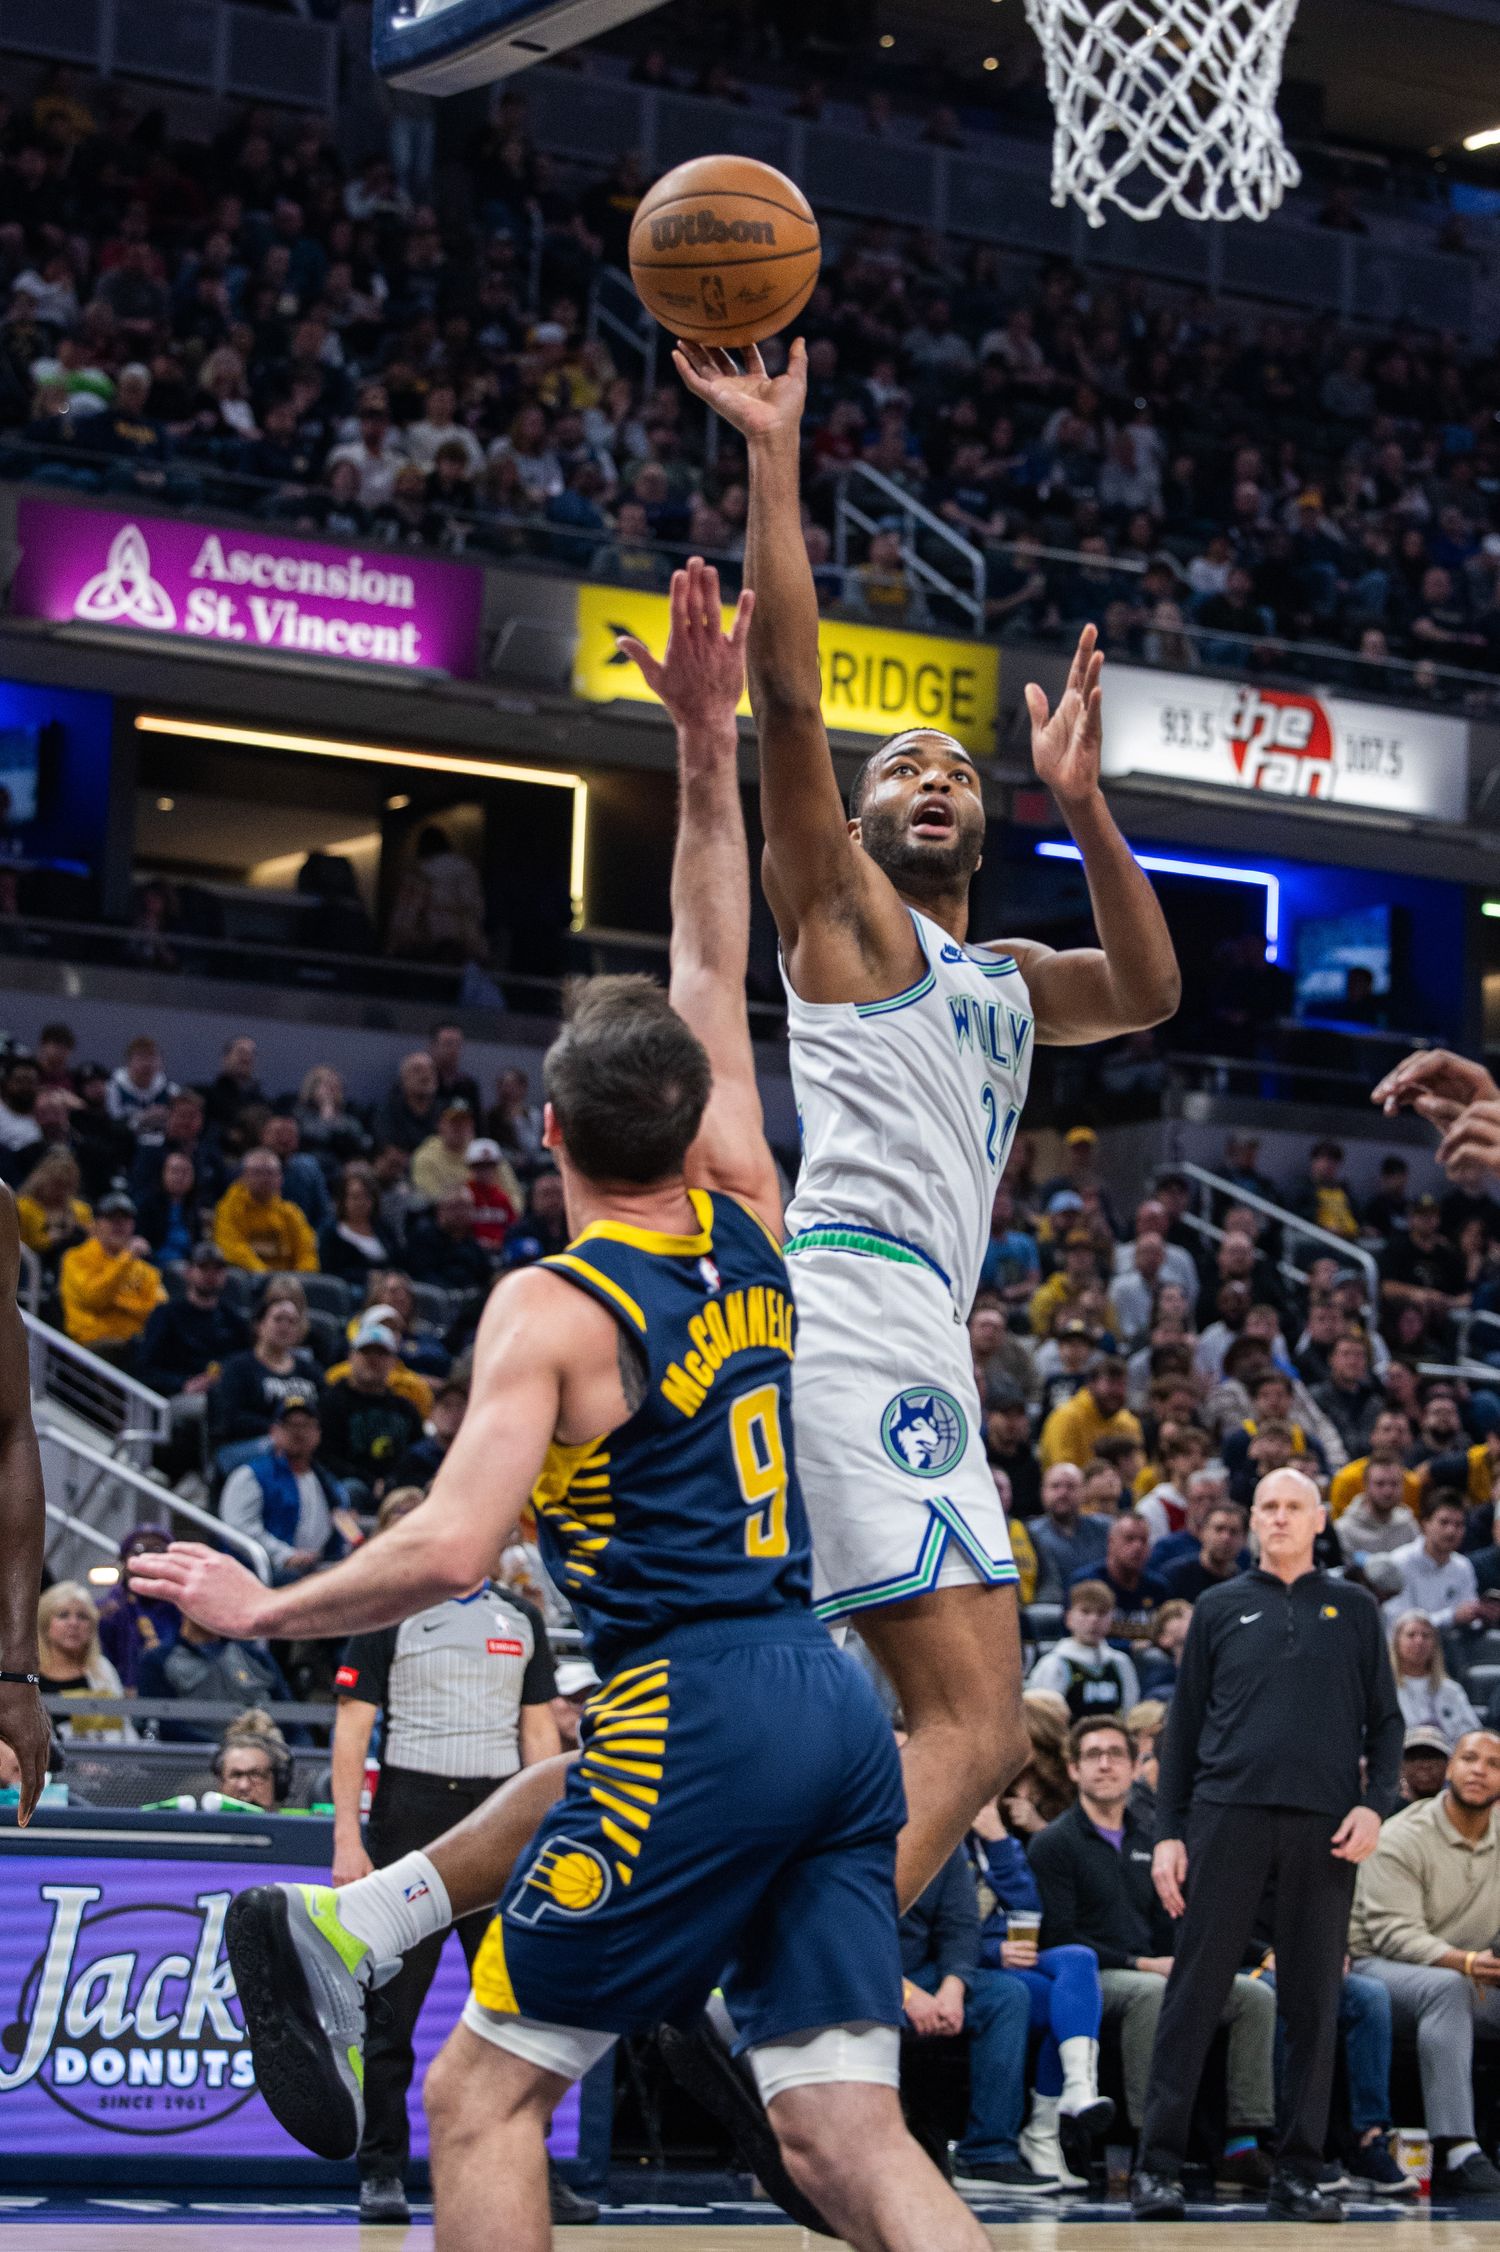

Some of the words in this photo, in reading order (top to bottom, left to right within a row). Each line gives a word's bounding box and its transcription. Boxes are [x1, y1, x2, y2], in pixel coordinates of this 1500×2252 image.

[651, 210, 776, 251] Wilson
[190, 534, 416, 609] Ascension
[185, 587, 247, 641] St.
[248, 594, 421, 664] Vincent
[818, 648, 977, 725] RIDGE
[1226, 687, 1315, 750] the
[730, 1382, 790, 1557] 9
[53, 2047, 256, 2088] DONUTS
[100, 2095, 153, 2109] SINCE
